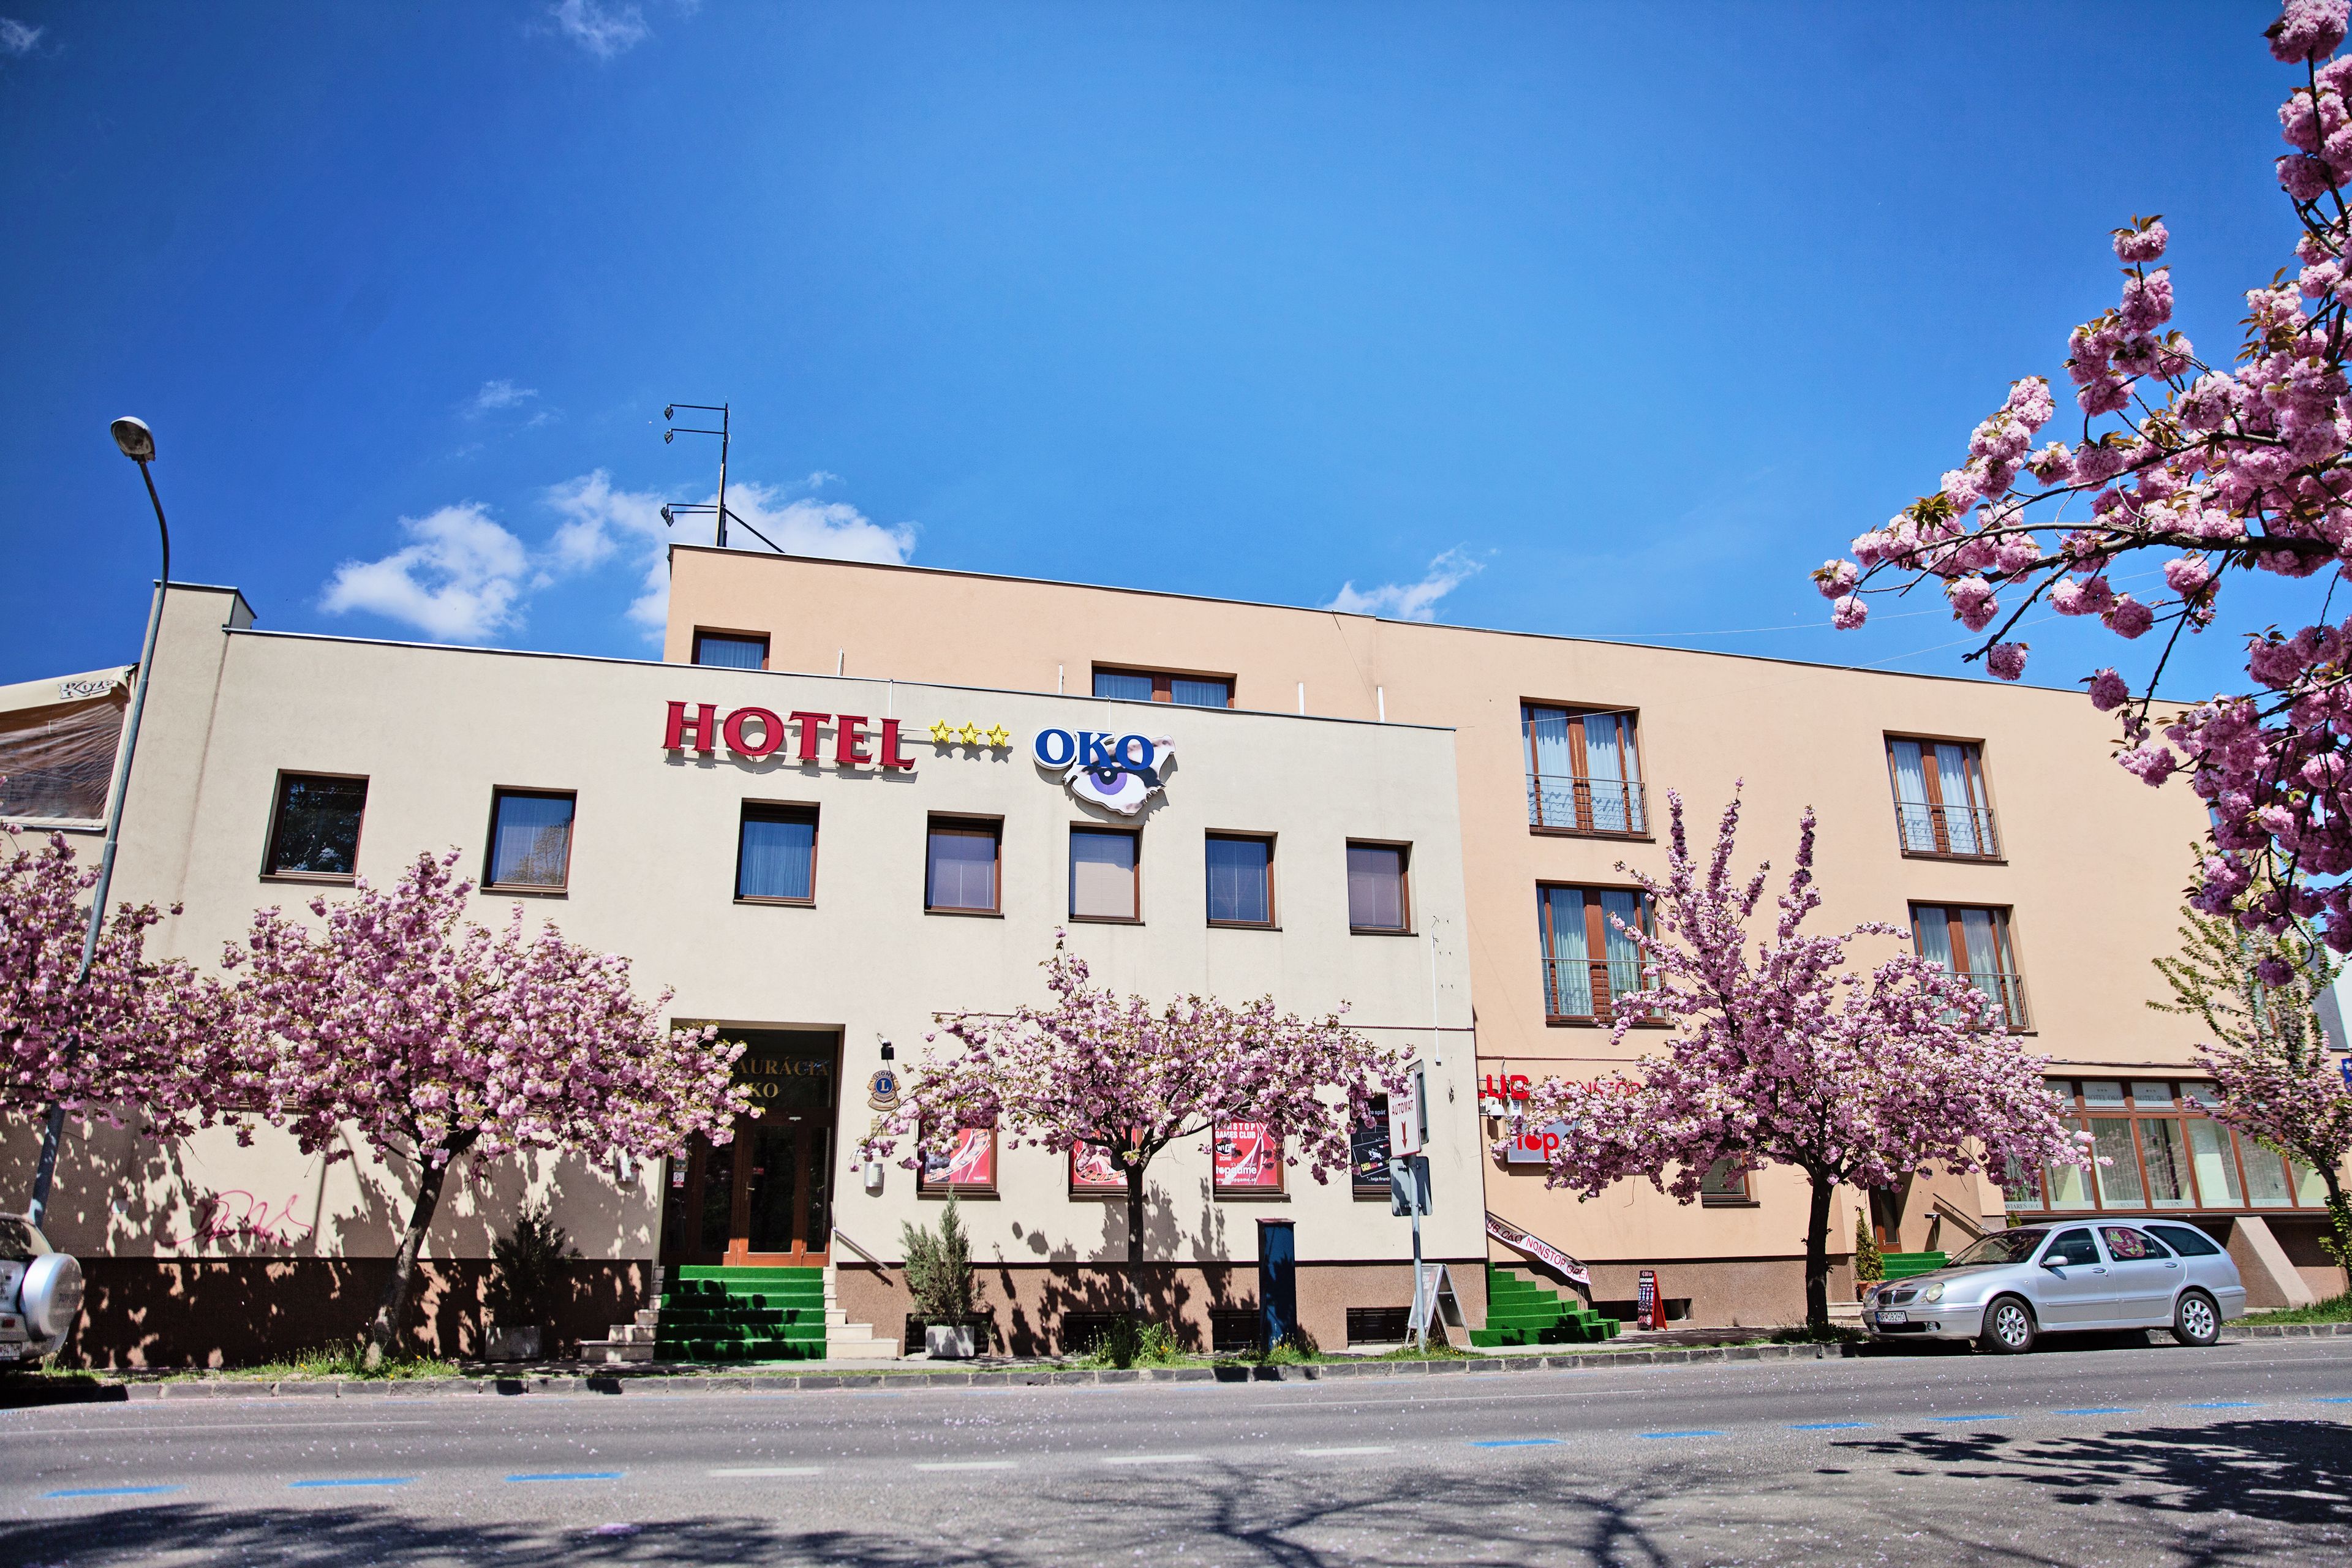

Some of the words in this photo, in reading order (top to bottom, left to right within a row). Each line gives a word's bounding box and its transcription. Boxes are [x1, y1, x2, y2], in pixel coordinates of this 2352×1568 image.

[58, 680, 118, 699] Koze
[662, 701, 916, 767] HOTEL
[1034, 728, 1155, 771] OKO
[736, 1056, 827, 1076] AURÁCIA
[1392, 1099, 1413, 1116] AUTOMAT
[1501, 1230, 1523, 1244] OKO
[1526, 1237, 1566, 1267] NONSTOP
